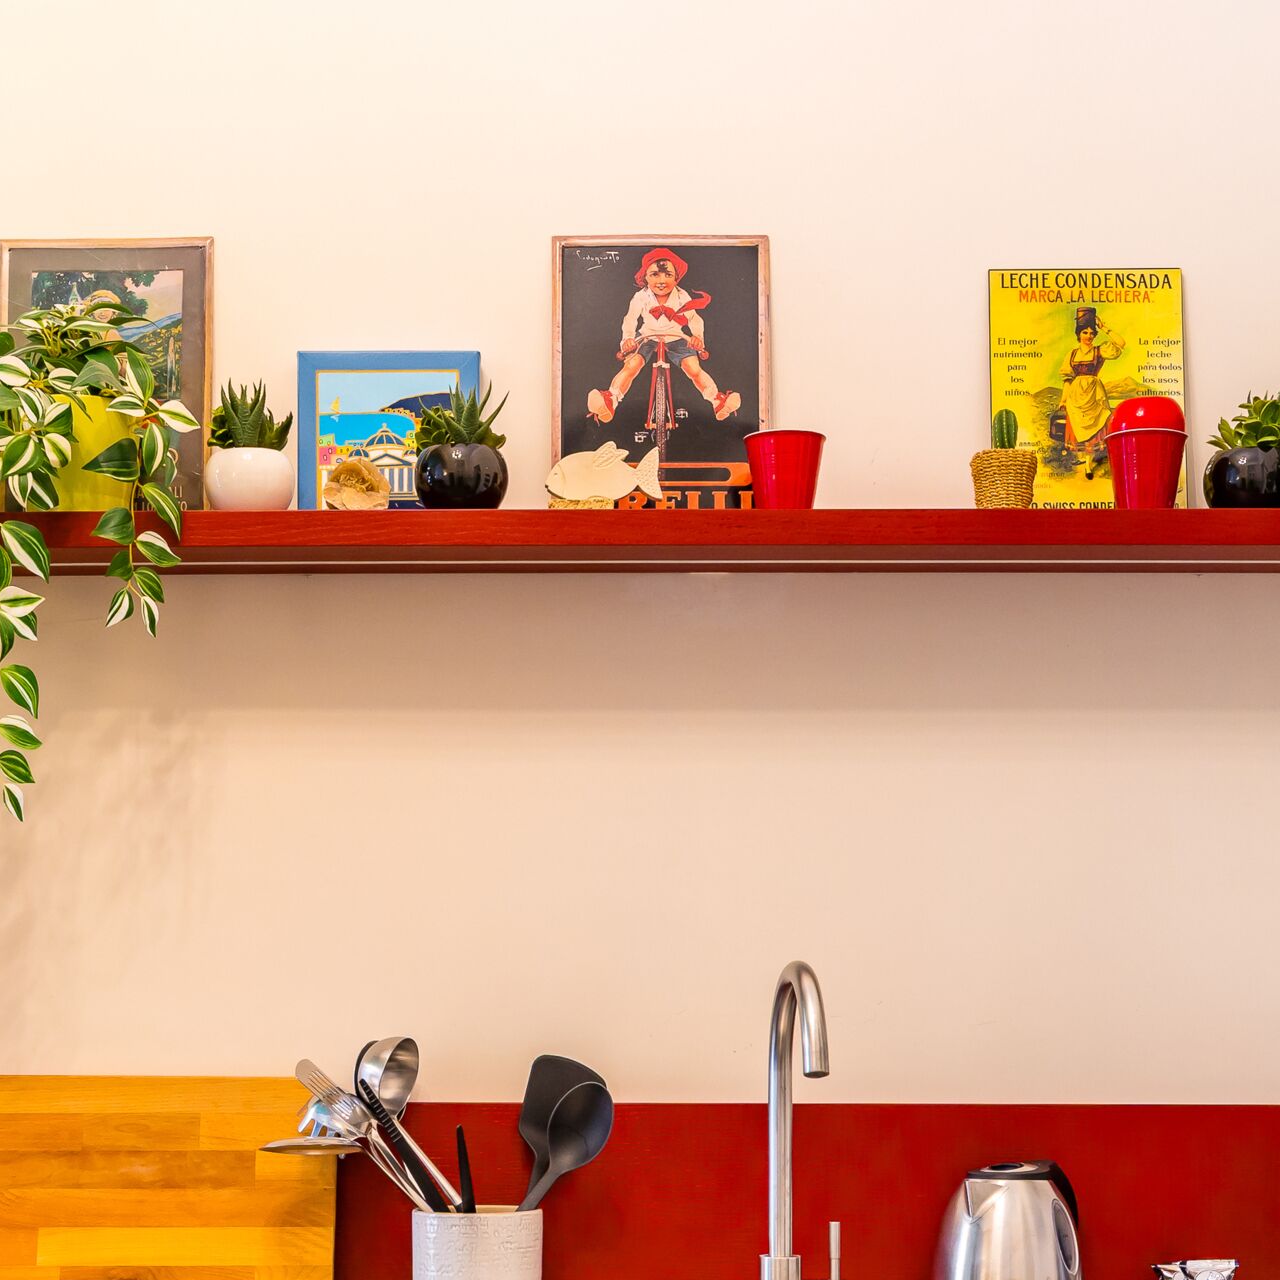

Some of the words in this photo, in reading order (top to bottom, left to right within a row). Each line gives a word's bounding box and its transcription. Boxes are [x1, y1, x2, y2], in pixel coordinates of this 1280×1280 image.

[1001, 273, 1051, 289] LECHE
[1055, 273, 1172, 289] CONDENSADA
[1019, 290, 1064, 303] MARCA
[998, 337, 1006, 346] El
[1009, 338, 1038, 348] mejor
[1138, 337, 1149, 346] La
[1152, 338, 1181, 348] mejor
[993, 351, 1043, 359] nutrimento
[1147, 350, 1172, 359] leche
[1007, 364, 1027, 373] para
[1138, 364, 1157, 372] para
[1158, 363, 1183, 371] todos
[1010, 375, 1025, 384] los
[1142, 375, 1156, 384] los
[1157, 376, 1179, 384] usos
